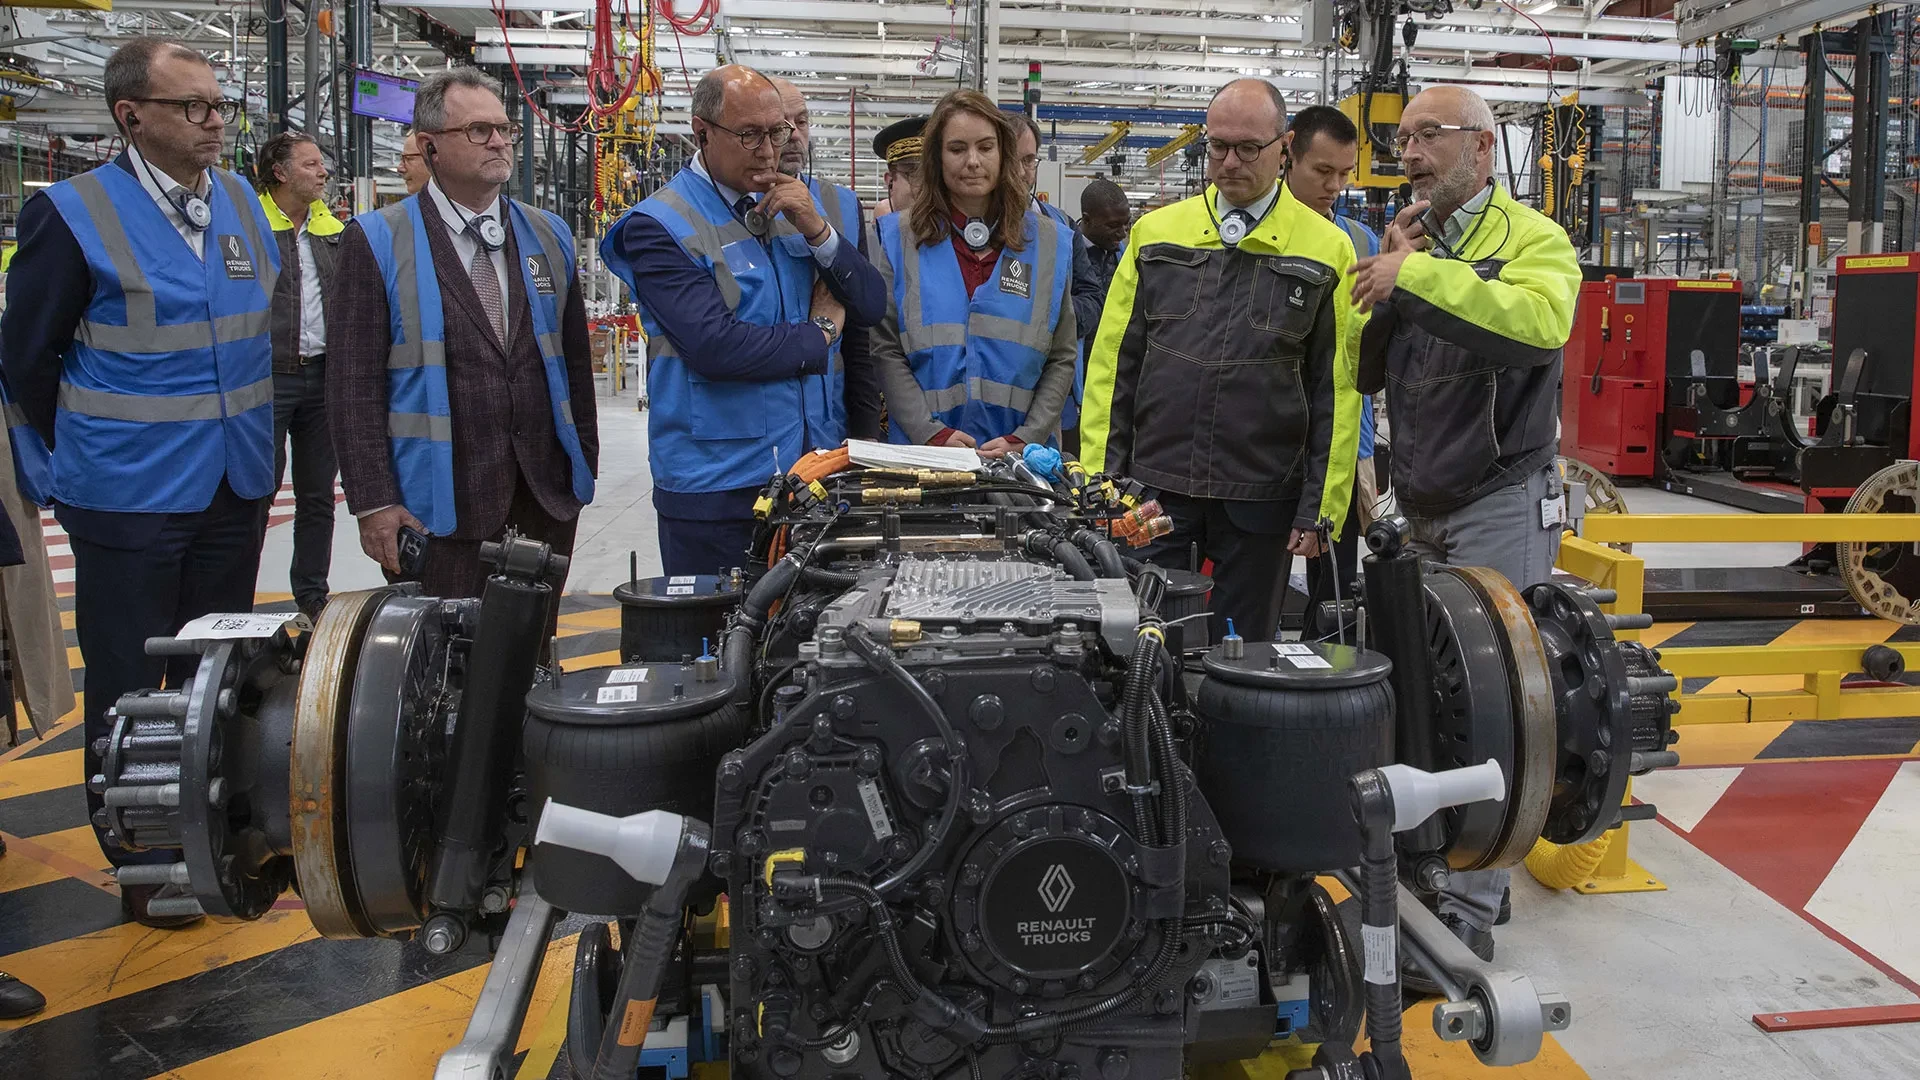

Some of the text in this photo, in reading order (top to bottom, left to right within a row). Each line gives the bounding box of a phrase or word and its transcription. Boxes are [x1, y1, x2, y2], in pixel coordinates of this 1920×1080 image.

[1001, 276, 1029, 288] RENAULT
[1002, 281, 1027, 293] TRUCKS
[1017, 917, 1097, 933] RENAULT
[1021, 931, 1091, 945] TRUCKS
